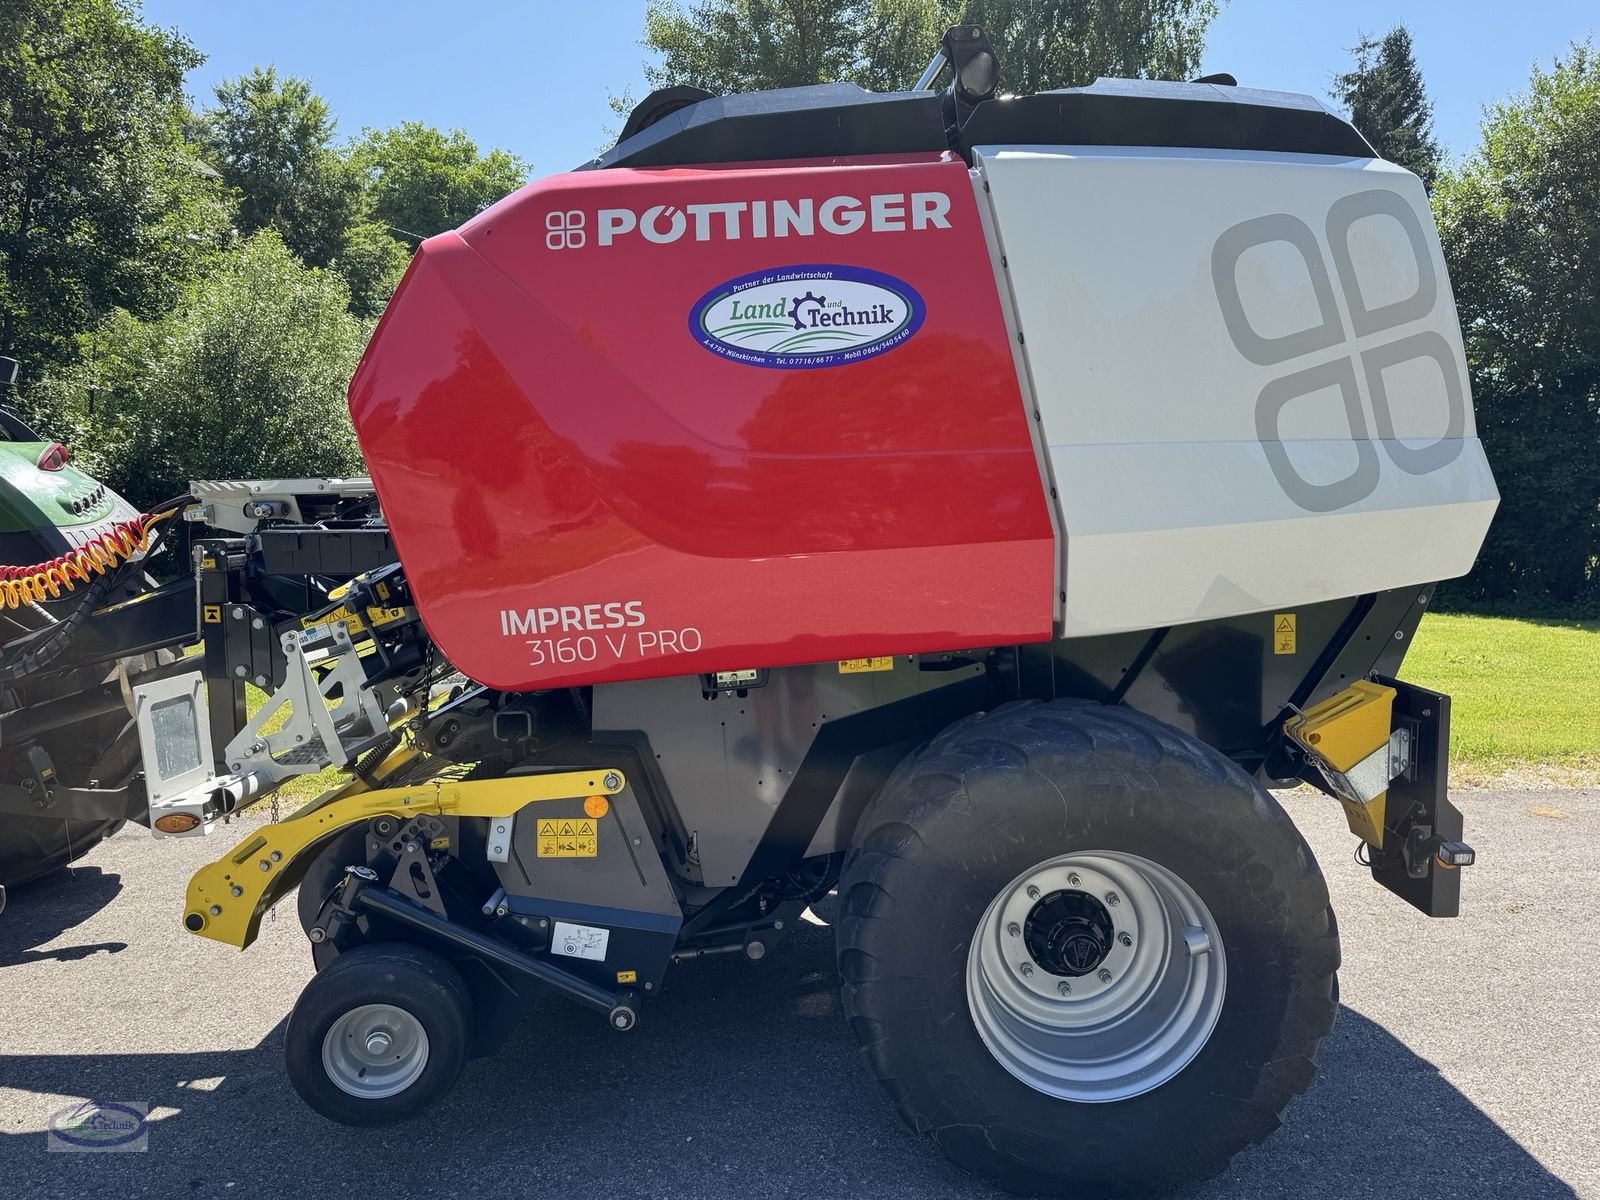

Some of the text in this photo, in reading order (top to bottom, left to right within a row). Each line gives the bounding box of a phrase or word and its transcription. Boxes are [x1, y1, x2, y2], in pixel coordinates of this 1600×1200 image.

[597, 191, 953, 247] PÖTTINGER
[733, 271, 833, 293] Partner der Landwirtschaft
[730, 297, 894, 328] Land und Technik
[703, 339, 725, 354] A-4792
[726, 349, 766, 363] Münzkirchen
[844, 350, 862, 360] Mobil
[500, 600, 646, 636] IMPRESS
[526, 627, 702, 666] 3160 V PRO
